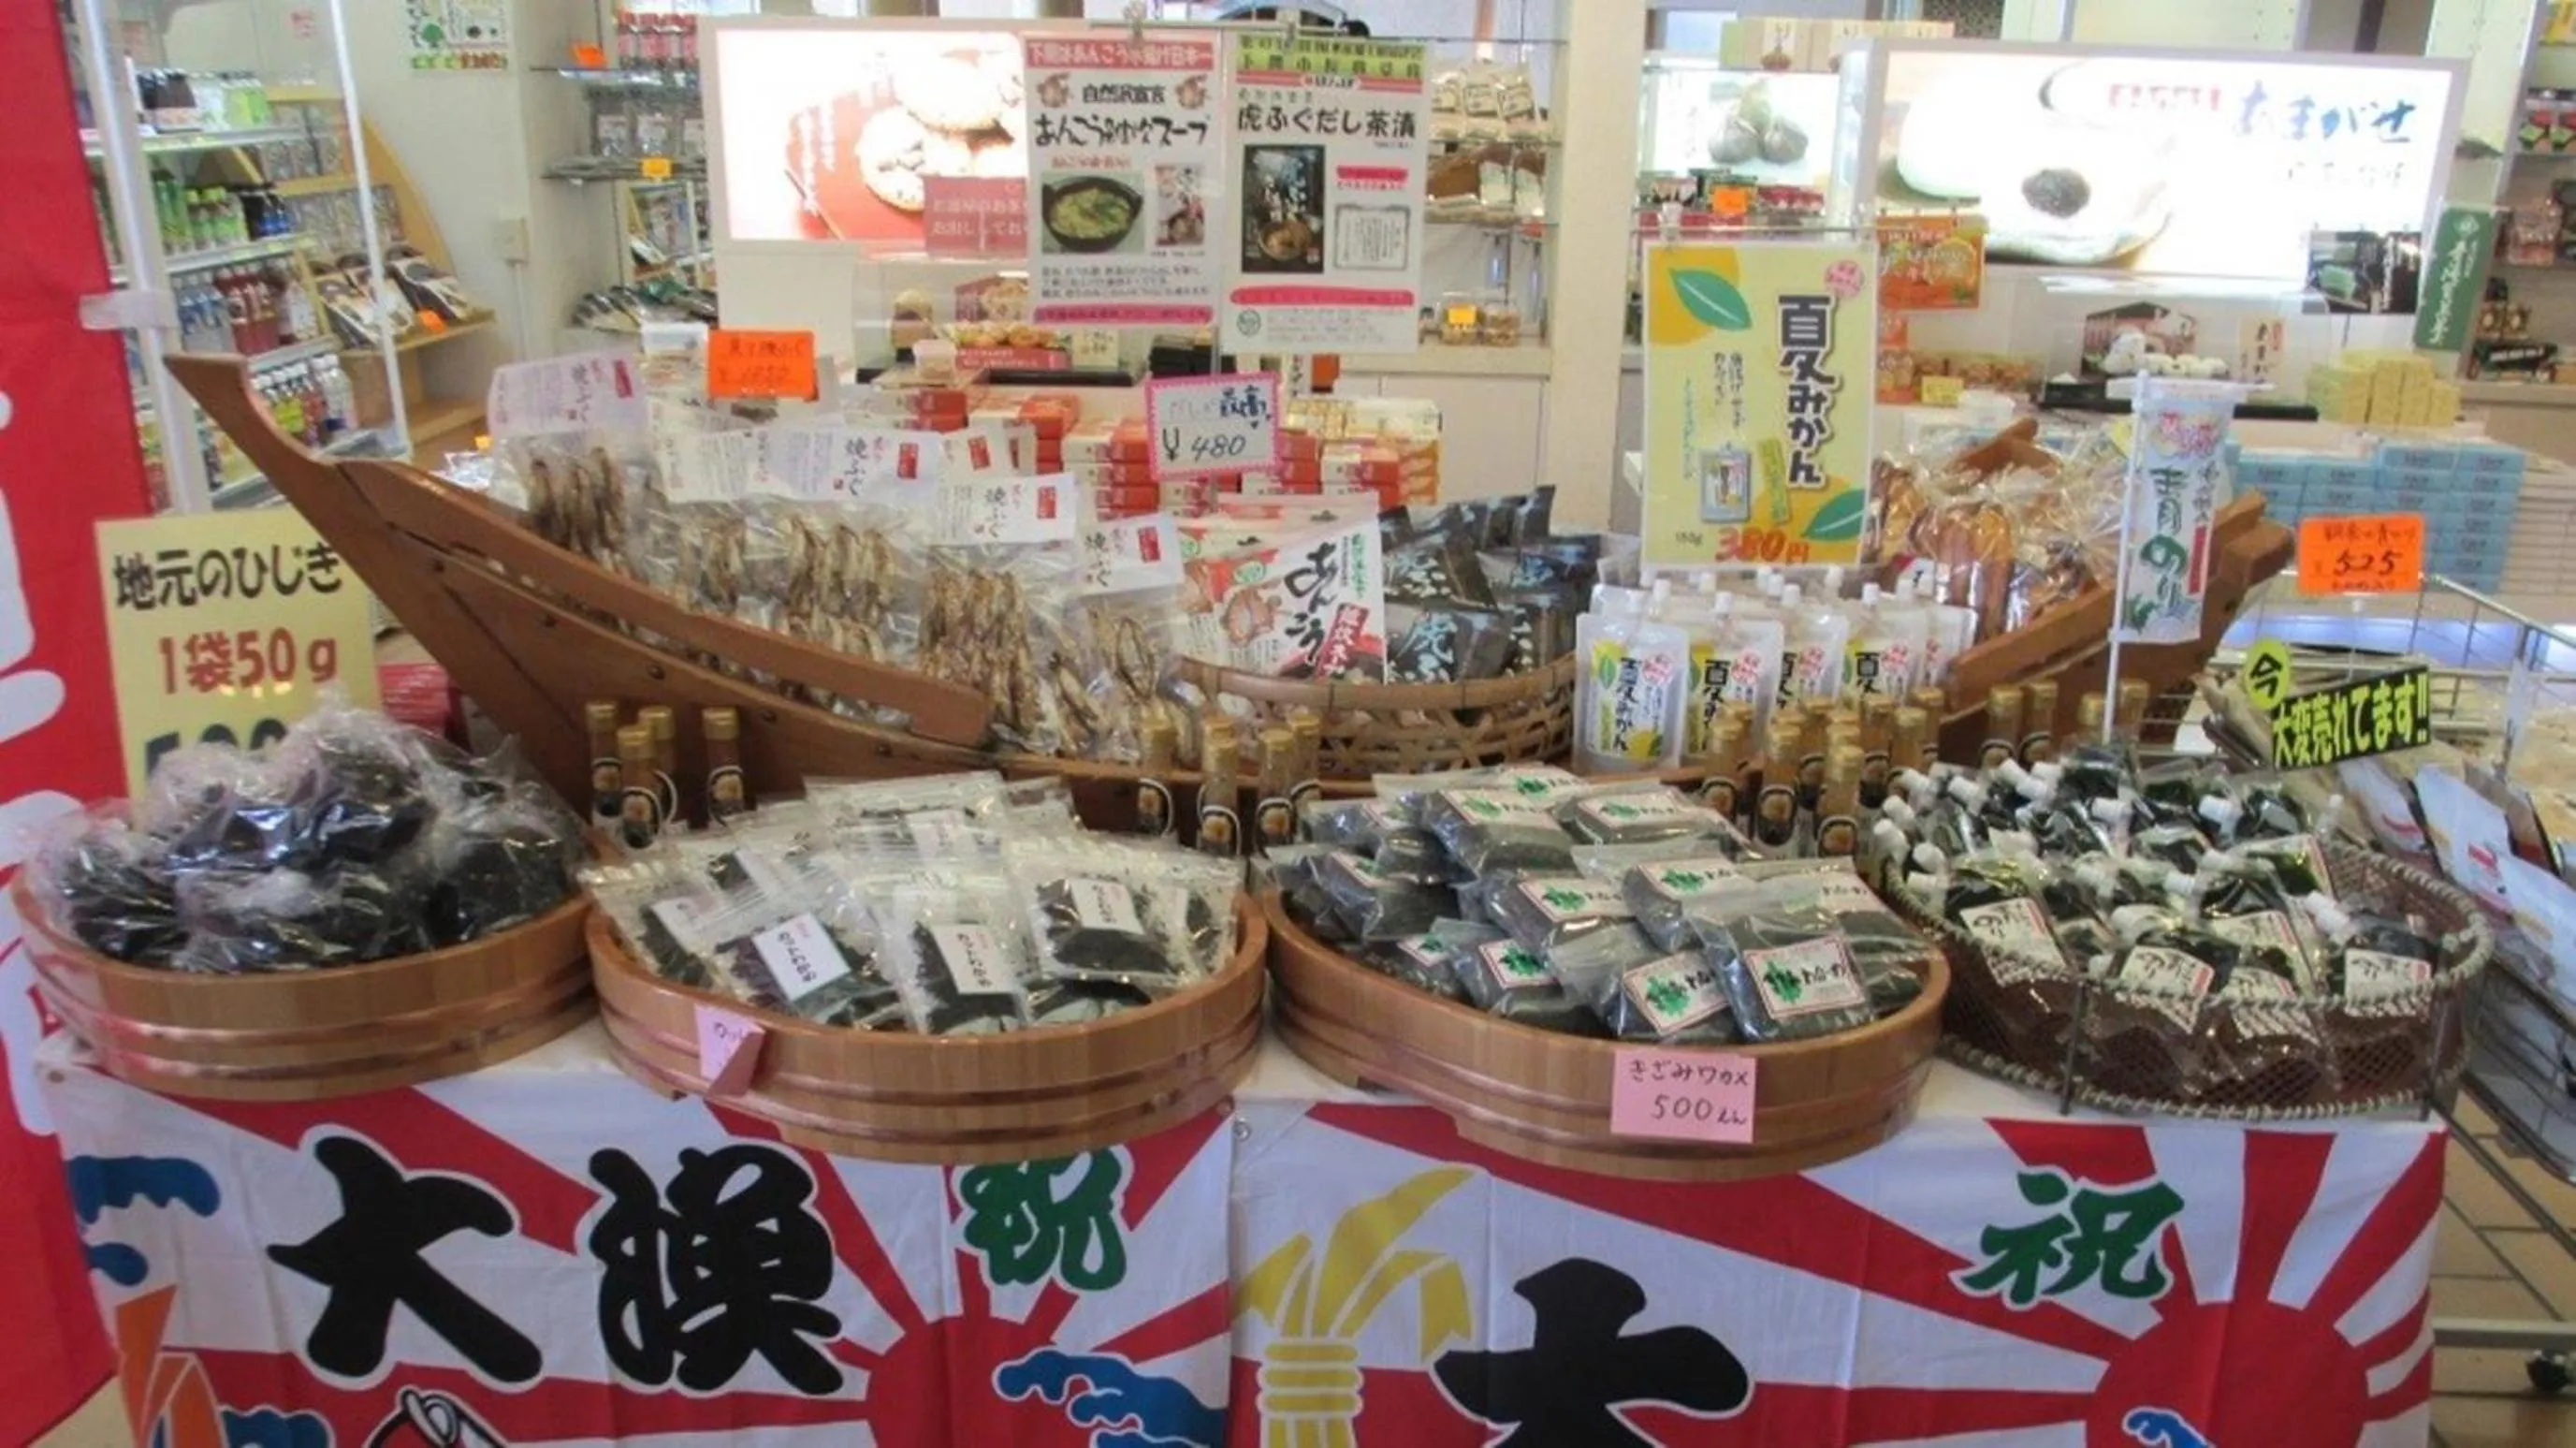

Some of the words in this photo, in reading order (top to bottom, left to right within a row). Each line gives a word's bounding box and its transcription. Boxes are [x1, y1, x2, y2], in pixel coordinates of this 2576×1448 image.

[1778, 294, 1837, 486] 夏みかん
[114, 541, 343, 611] 地元のひじき
[1714, 526, 1811, 565] 380円
[2139, 466, 2189, 619] 青のり
[160, 628, 339, 695] 1袋50g
[2249, 652, 2283, 699] 今
[1612, 655, 1644, 753] 夏みかん
[1629, 1059, 1750, 1087] きざみワカメ
[267, 1134, 845, 1395] 大漁
[1967, 1170, 2186, 1303] 祝
